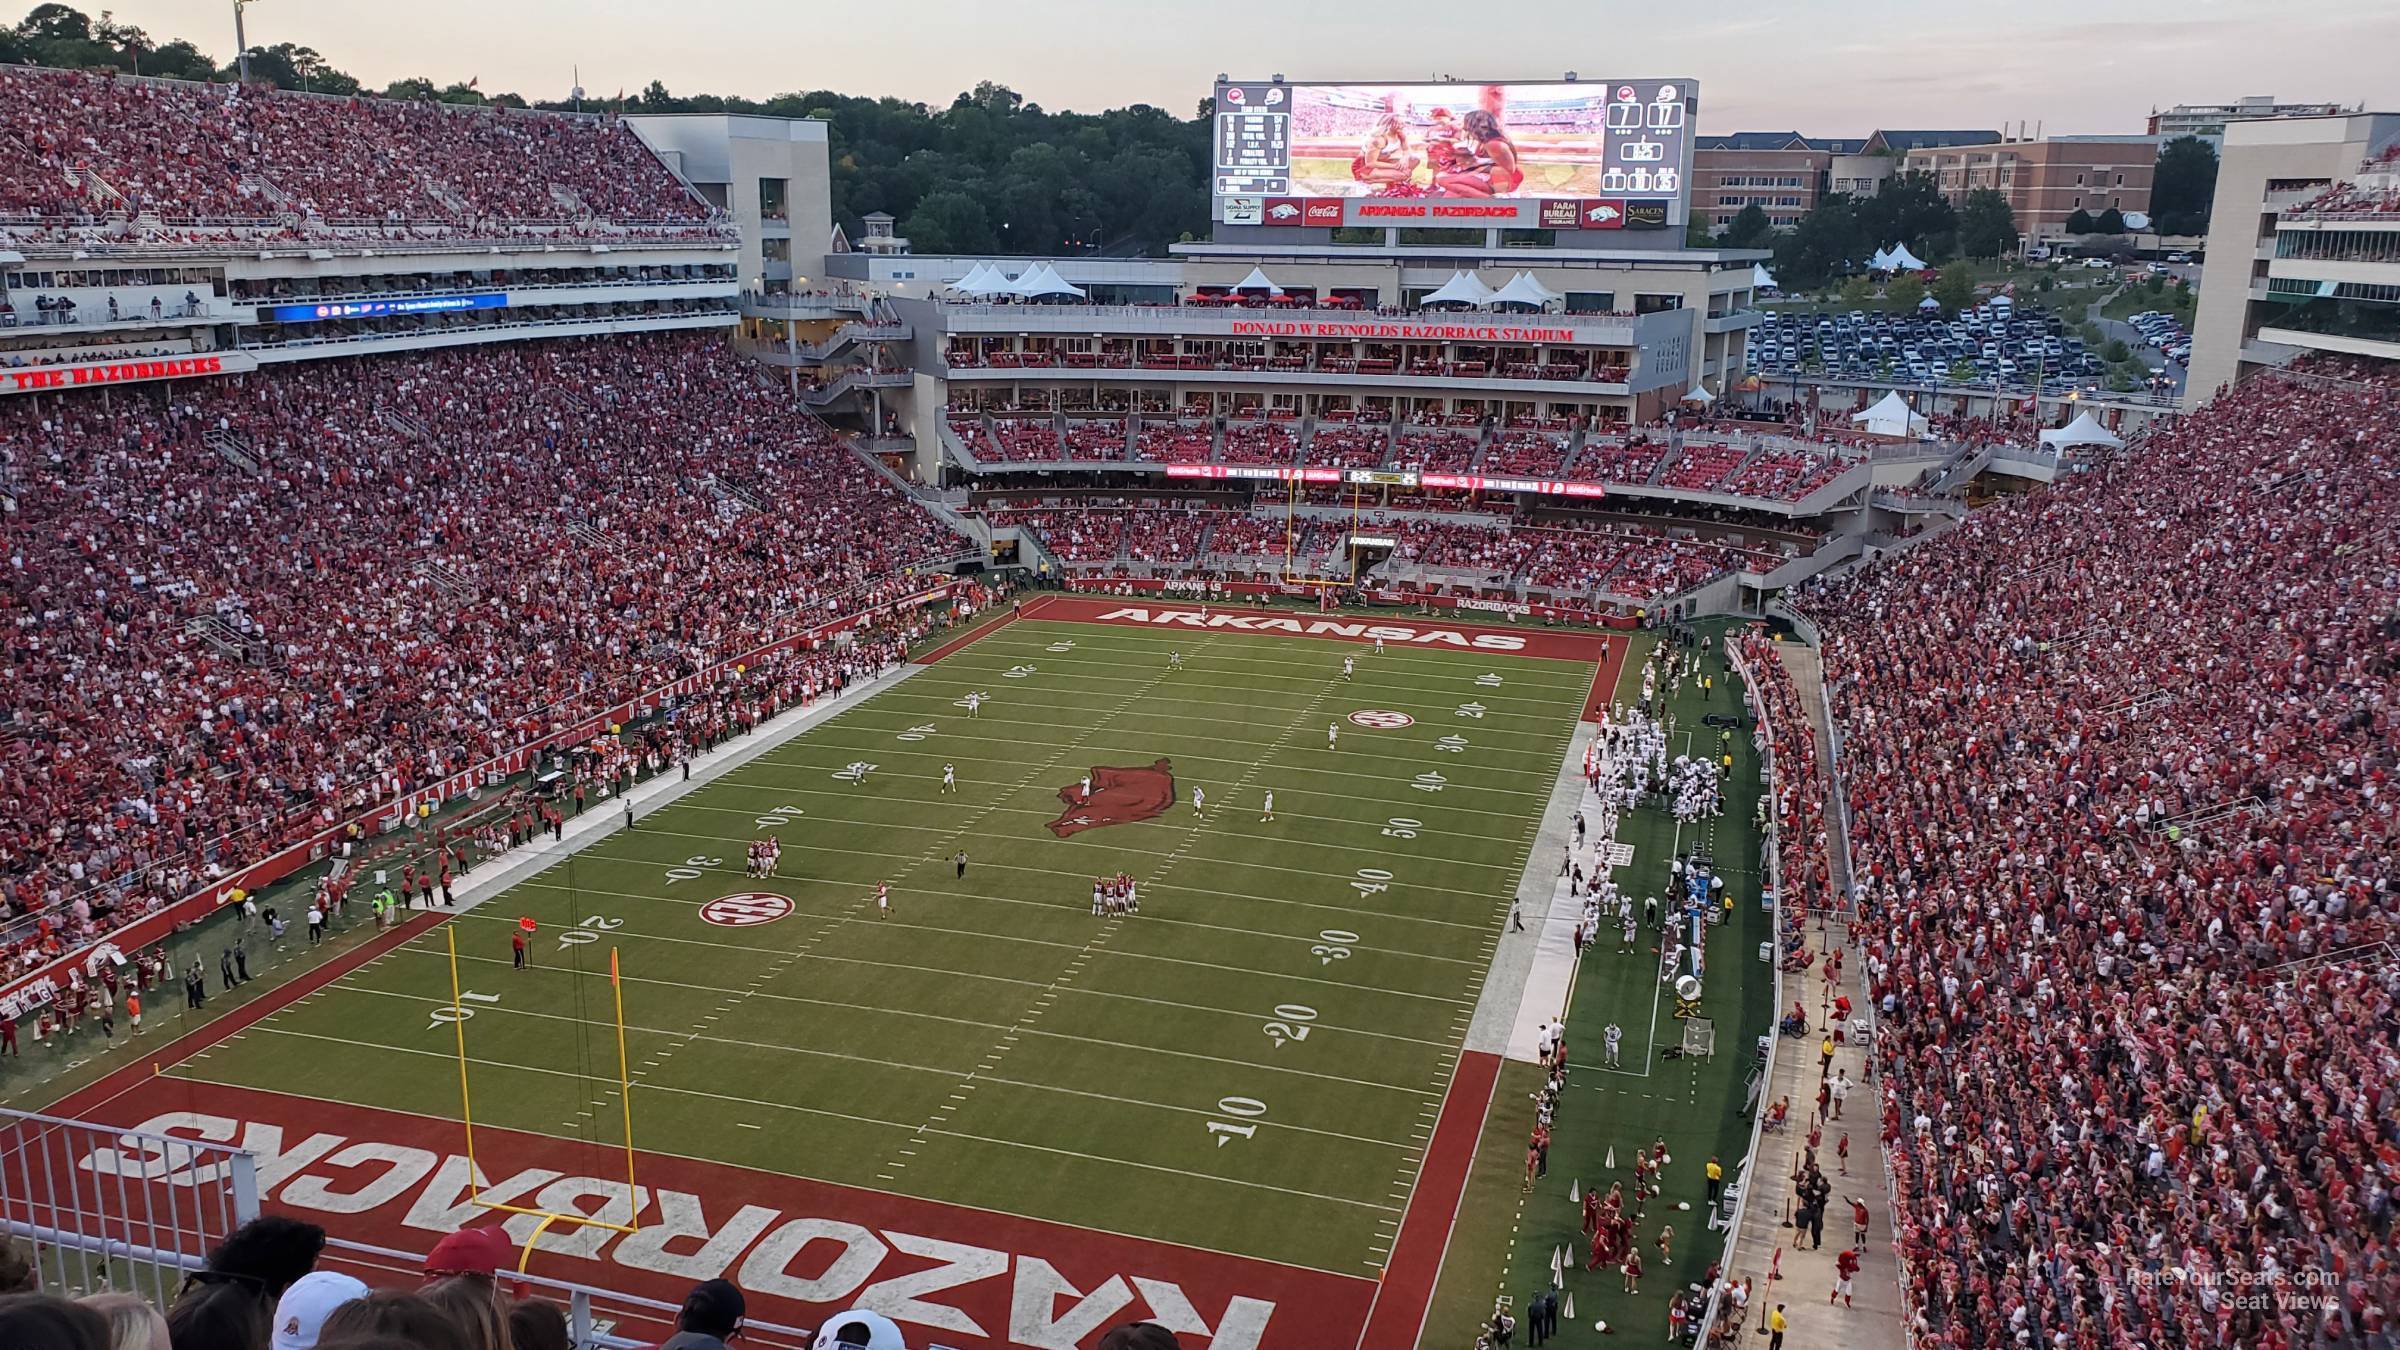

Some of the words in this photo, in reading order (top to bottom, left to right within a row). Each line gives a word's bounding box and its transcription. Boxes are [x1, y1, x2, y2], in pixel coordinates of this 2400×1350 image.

[1621, 105, 1629, 126] 7
[1658, 105, 1672, 125] 17
[1359, 206, 1425, 216] ARKANSAS
[1433, 206, 1517, 217] RAZORBACKS
[1233, 322, 1296, 335] DONALD
[1300, 324, 1314, 335] W
[1317, 324, 1399, 337] REYNOLDS
[1402, 326, 1498, 339] RAZORBACK
[1503, 328, 1574, 342] STADIUM
[12, 370, 64, 389] THE
[73, 357, 221, 384] RAZORBACKS
[1457, 599, 1530, 614] RAZORBACKS
[1096, 607, 1527, 650] ARKANSAS
[1474, 675, 1503, 687] 10
[1454, 703, 1487, 719] 20
[896, 725, 937, 741] 40
[1434, 736, 1469, 753] 30
[1410, 774, 1447, 792] 40
[755, 805, 804, 826] 40
[1381, 818, 1423, 839] 50
[665, 856, 723, 879] 30
[1351, 869, 1393, 893] 40
[702, 893, 792, 925] SEC
[558, 915, 624, 944] 20
[1311, 930, 1359, 959] 30
[430, 990, 500, 1022] 10
[1263, 1004, 1318, 1041] 20
[1207, 1096, 1267, 1139] 10
